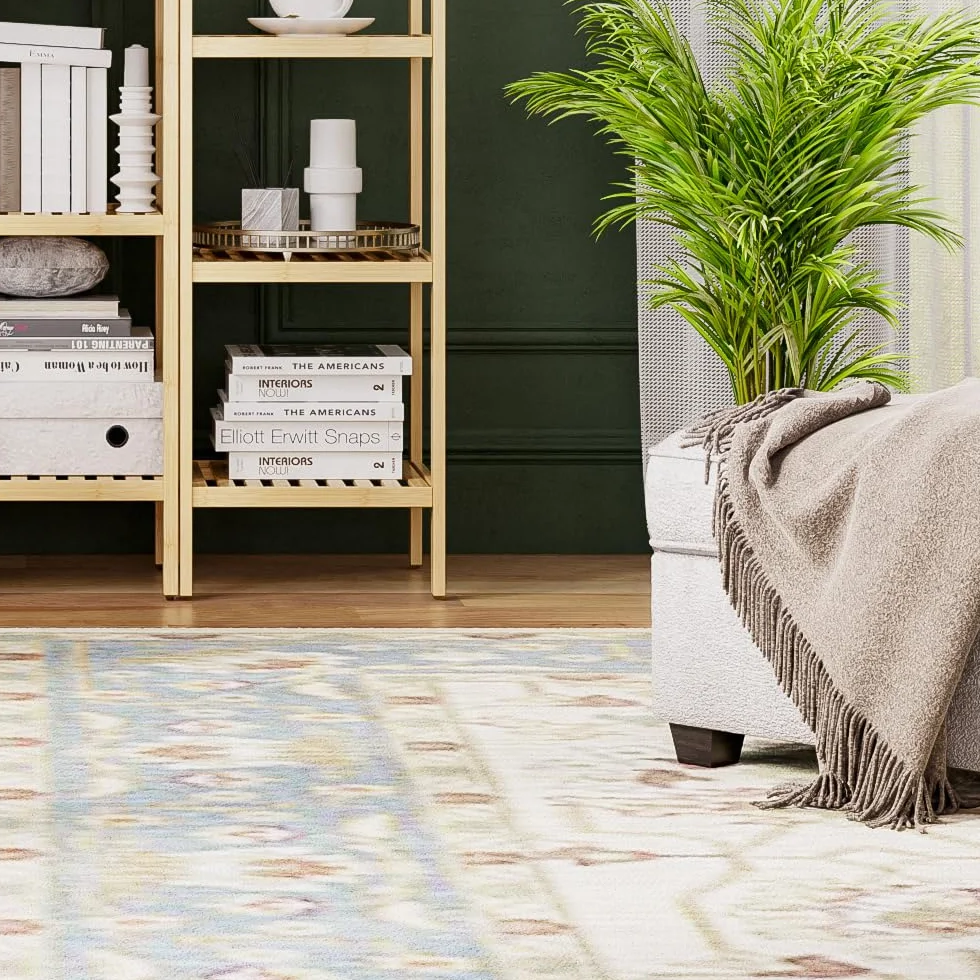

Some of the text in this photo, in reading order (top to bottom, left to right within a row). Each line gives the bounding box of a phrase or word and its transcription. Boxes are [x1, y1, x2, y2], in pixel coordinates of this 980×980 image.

[71, 340, 89, 349] 101
[91, 340, 149, 349] PARENTING
[44, 361, 86, 372] Woman
[96, 361, 109, 372] be
[110, 361, 121, 372] to
[123, 361, 149, 372] How
[292, 362, 385, 370] THE AMERICANS
[258, 379, 313, 388] INTERIORS
[373, 383, 385, 391] 2
[258, 389, 289, 398] NOW!
[283, 408, 376, 417] THE AMERICANS
[220, 428, 381, 447] Elliott Erwitt Snaps
[258, 456, 313, 466] INTERIORS
[373, 461, 385, 469] 2
[258, 466, 289, 476] NOW!
